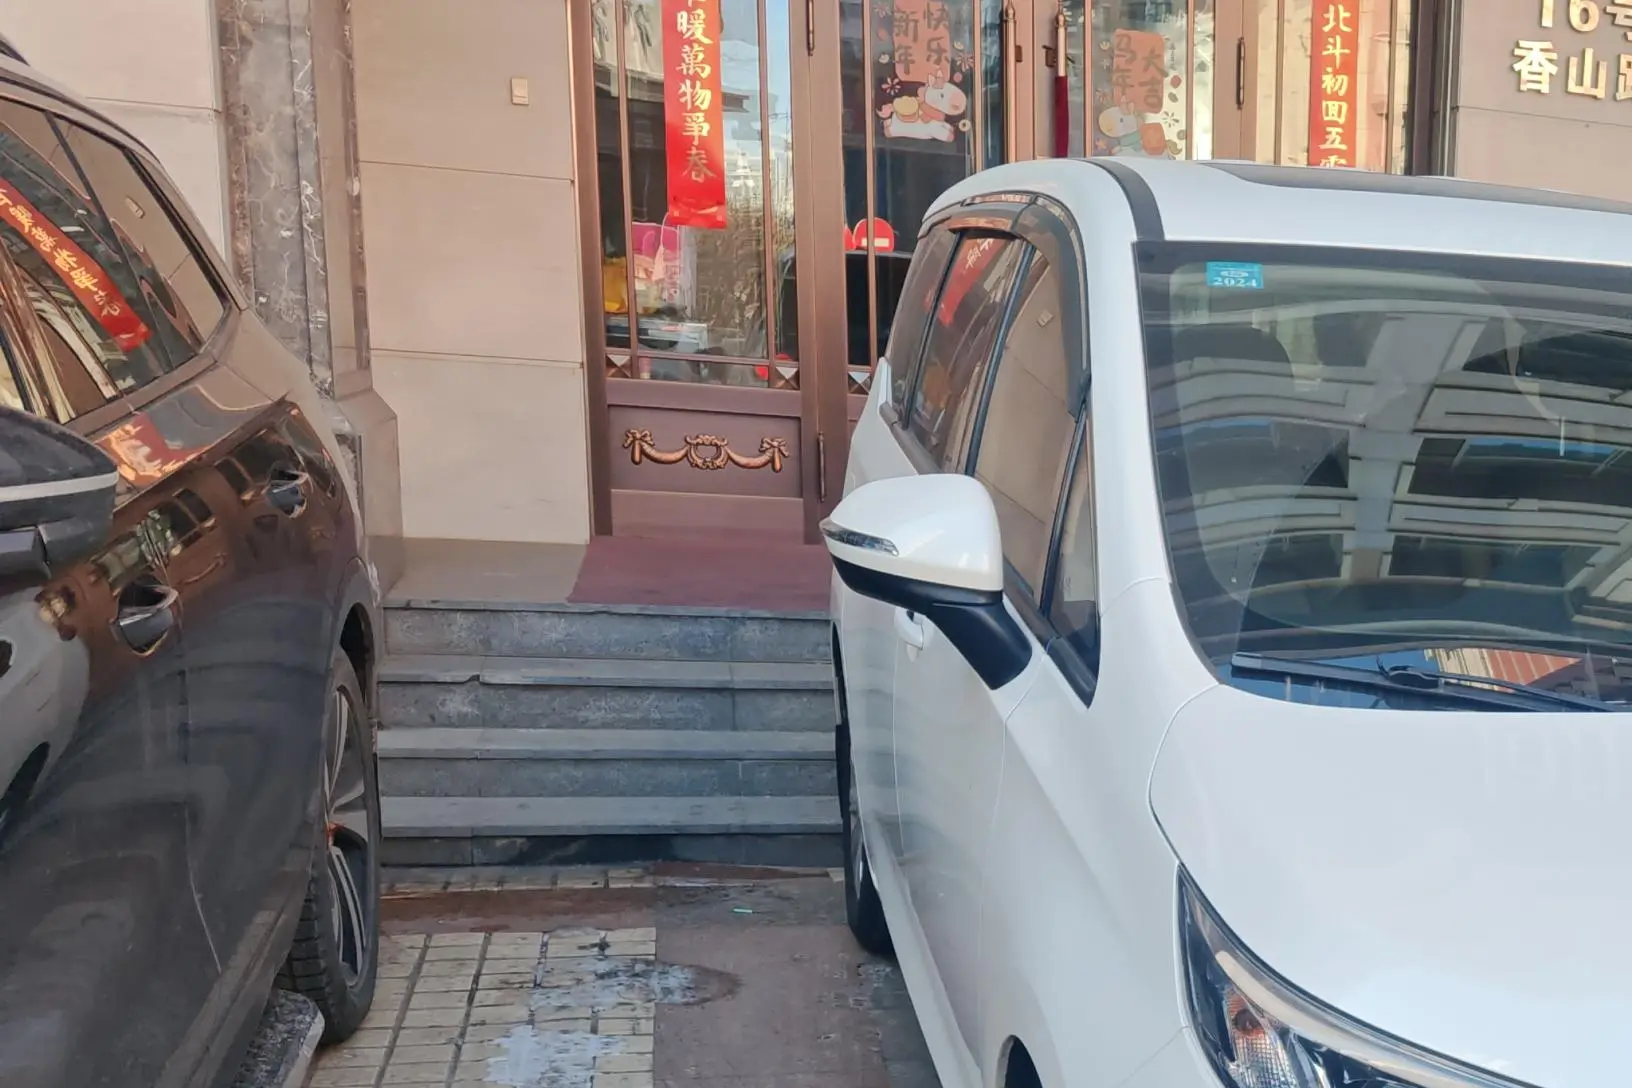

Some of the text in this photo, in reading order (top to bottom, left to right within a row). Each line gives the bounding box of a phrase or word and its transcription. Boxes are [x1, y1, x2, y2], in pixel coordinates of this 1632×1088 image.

[893, 10, 919, 75] 新年
[924, 1, 950, 65] 快乐
[675, 0, 718, 183] 暖萬物爭春
[1138, 47, 1169, 109] 大吉
[1212, 276, 1258, 287] 2024
